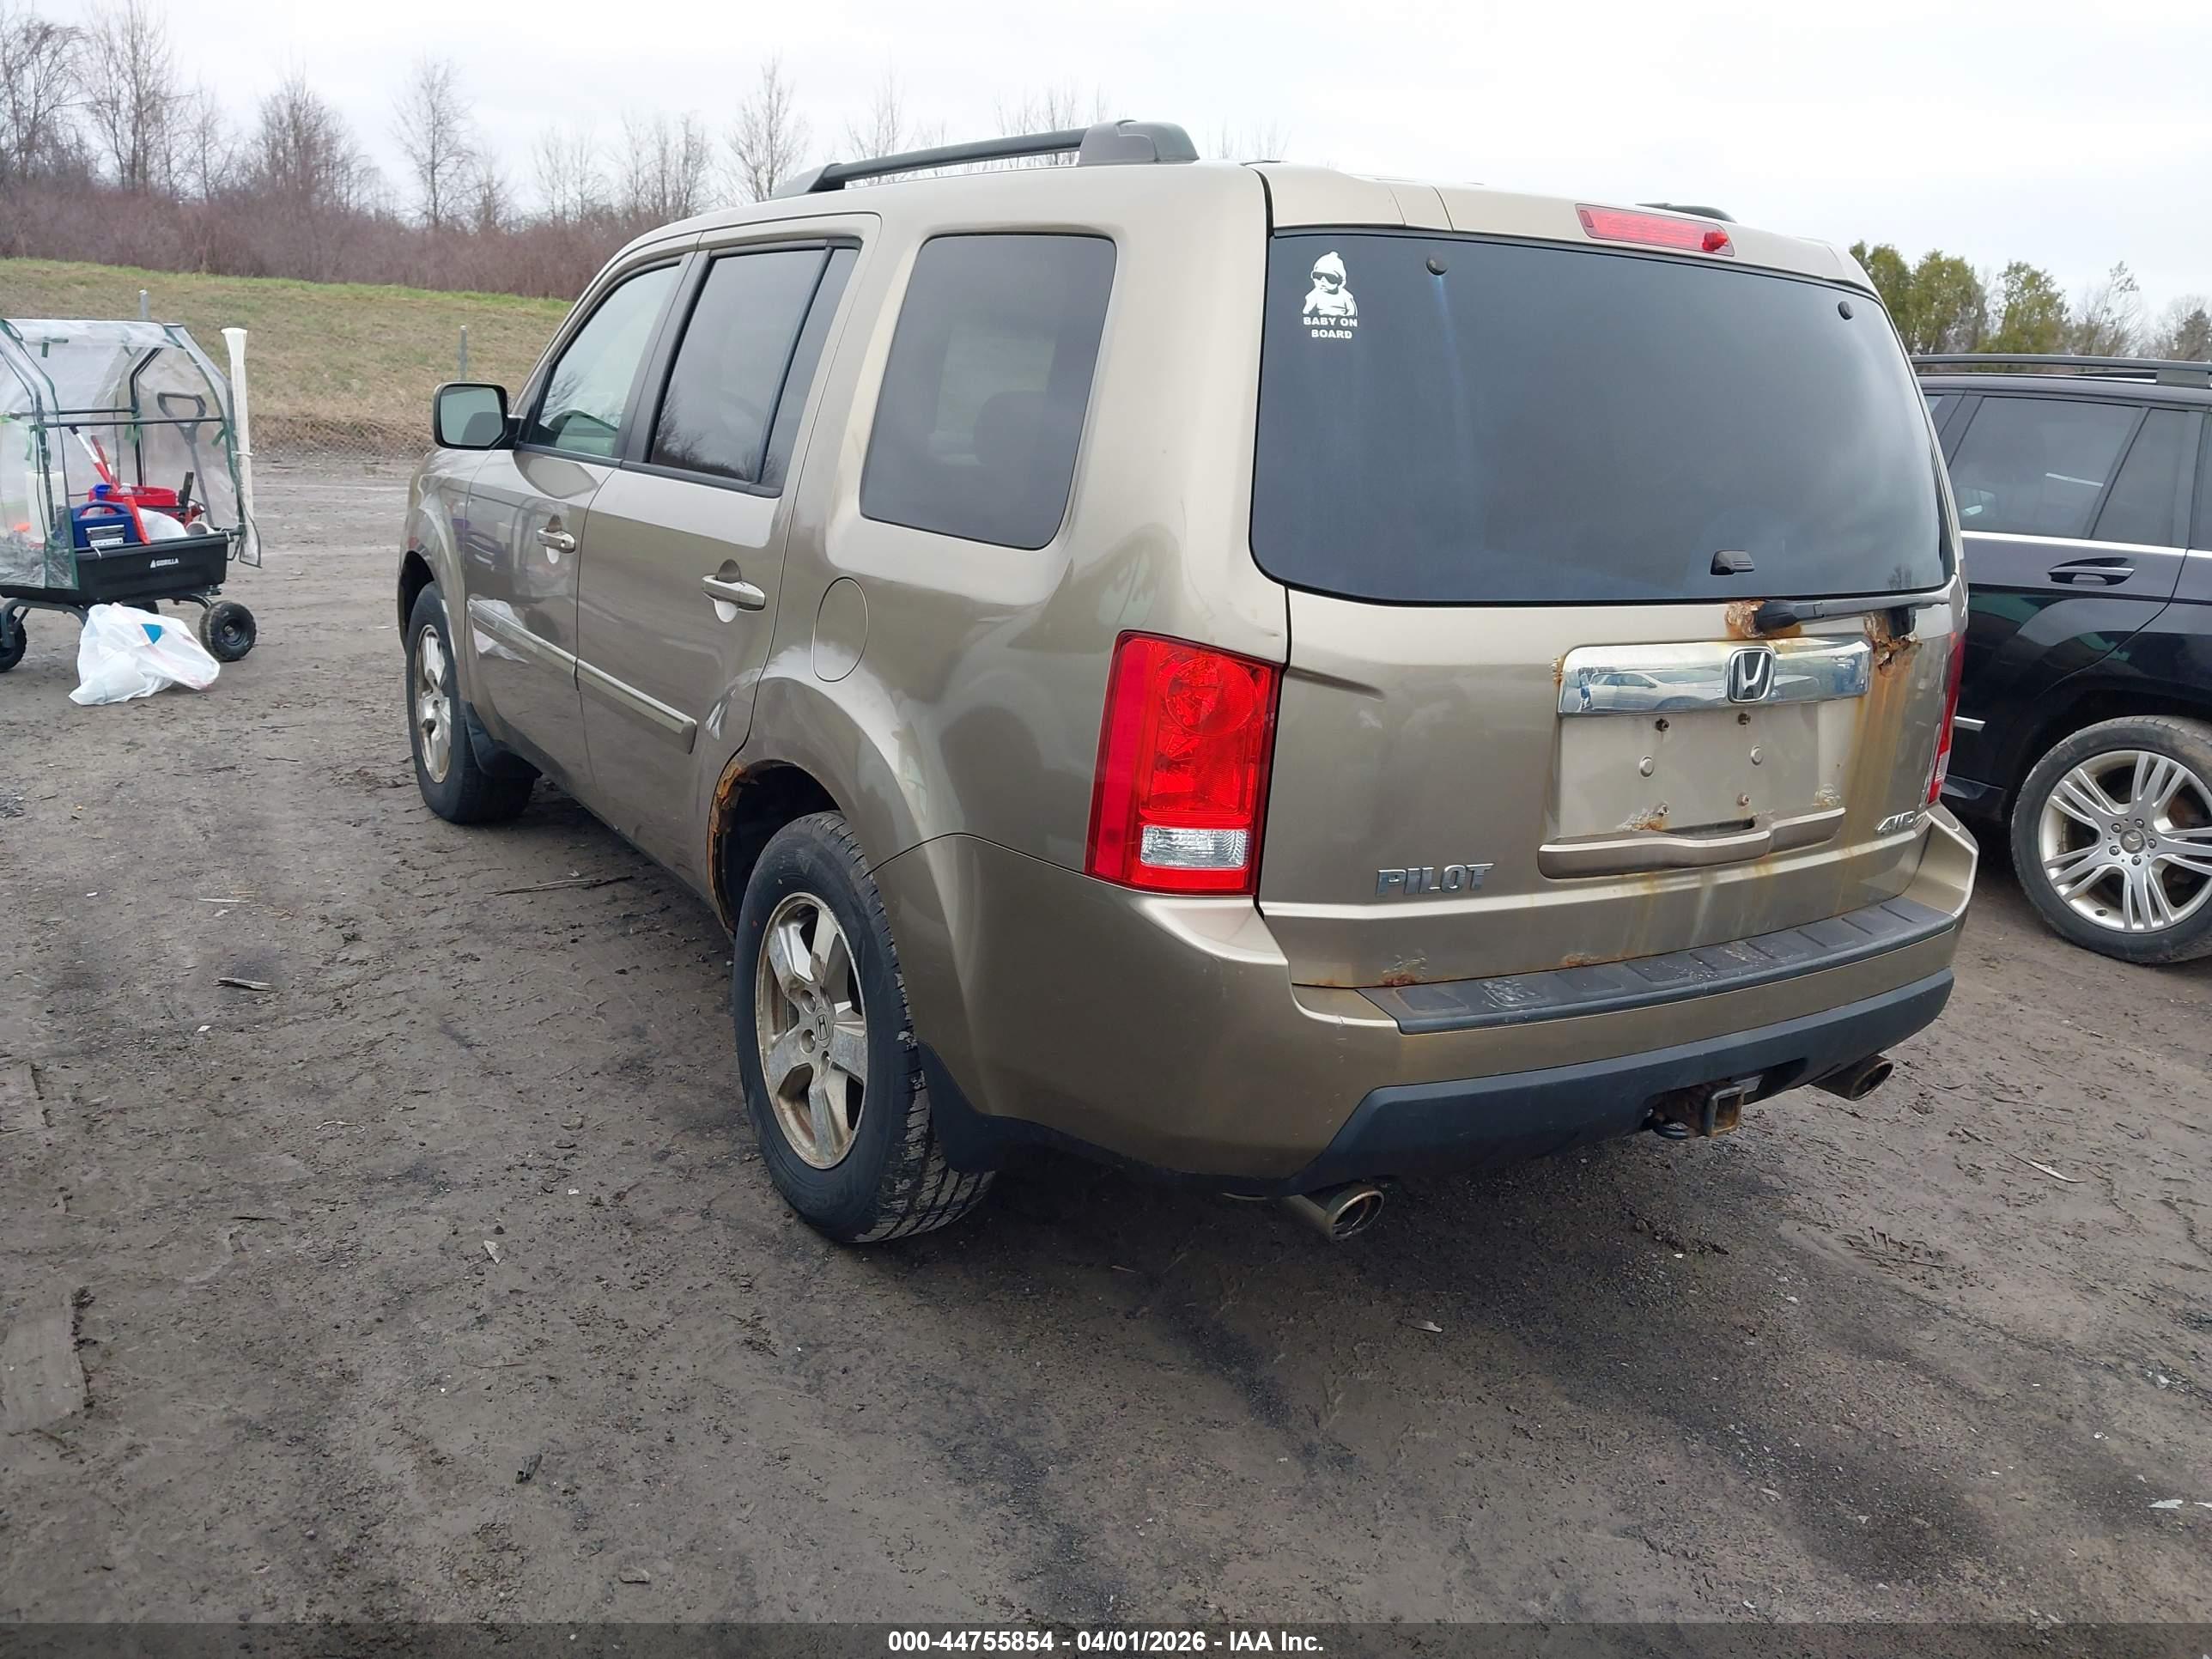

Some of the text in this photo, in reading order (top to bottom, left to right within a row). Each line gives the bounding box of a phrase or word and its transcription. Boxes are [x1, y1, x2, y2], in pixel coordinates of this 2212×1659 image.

[1303, 316, 1358, 327] BABY ON
[1311, 329, 1352, 339] BOARD
[1376, 863, 1495, 897] PILOT
